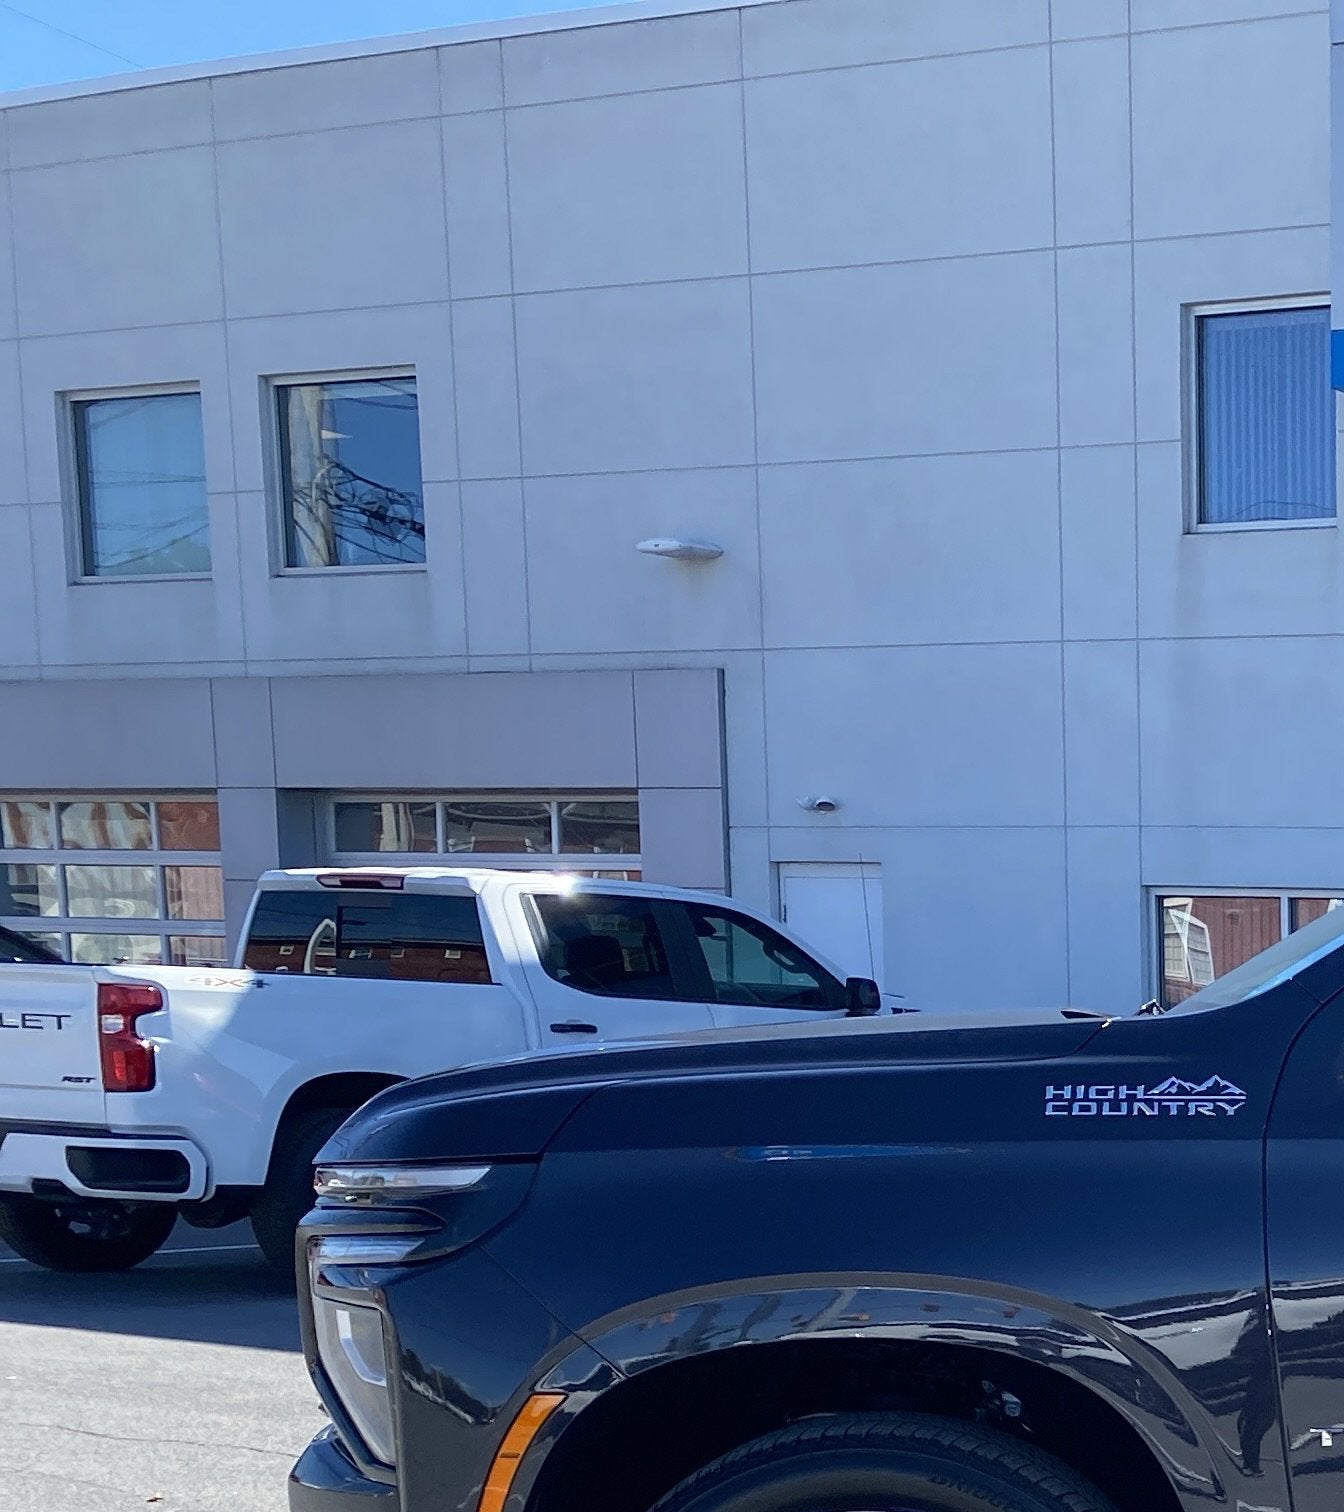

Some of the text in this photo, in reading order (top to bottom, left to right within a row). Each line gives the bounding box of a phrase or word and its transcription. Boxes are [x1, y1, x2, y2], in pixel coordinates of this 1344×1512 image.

[61, 1076, 96, 1084] RST
[1044, 1084, 1146, 1099] HIGH
[1044, 1101, 1247, 1116] COUNTRY
